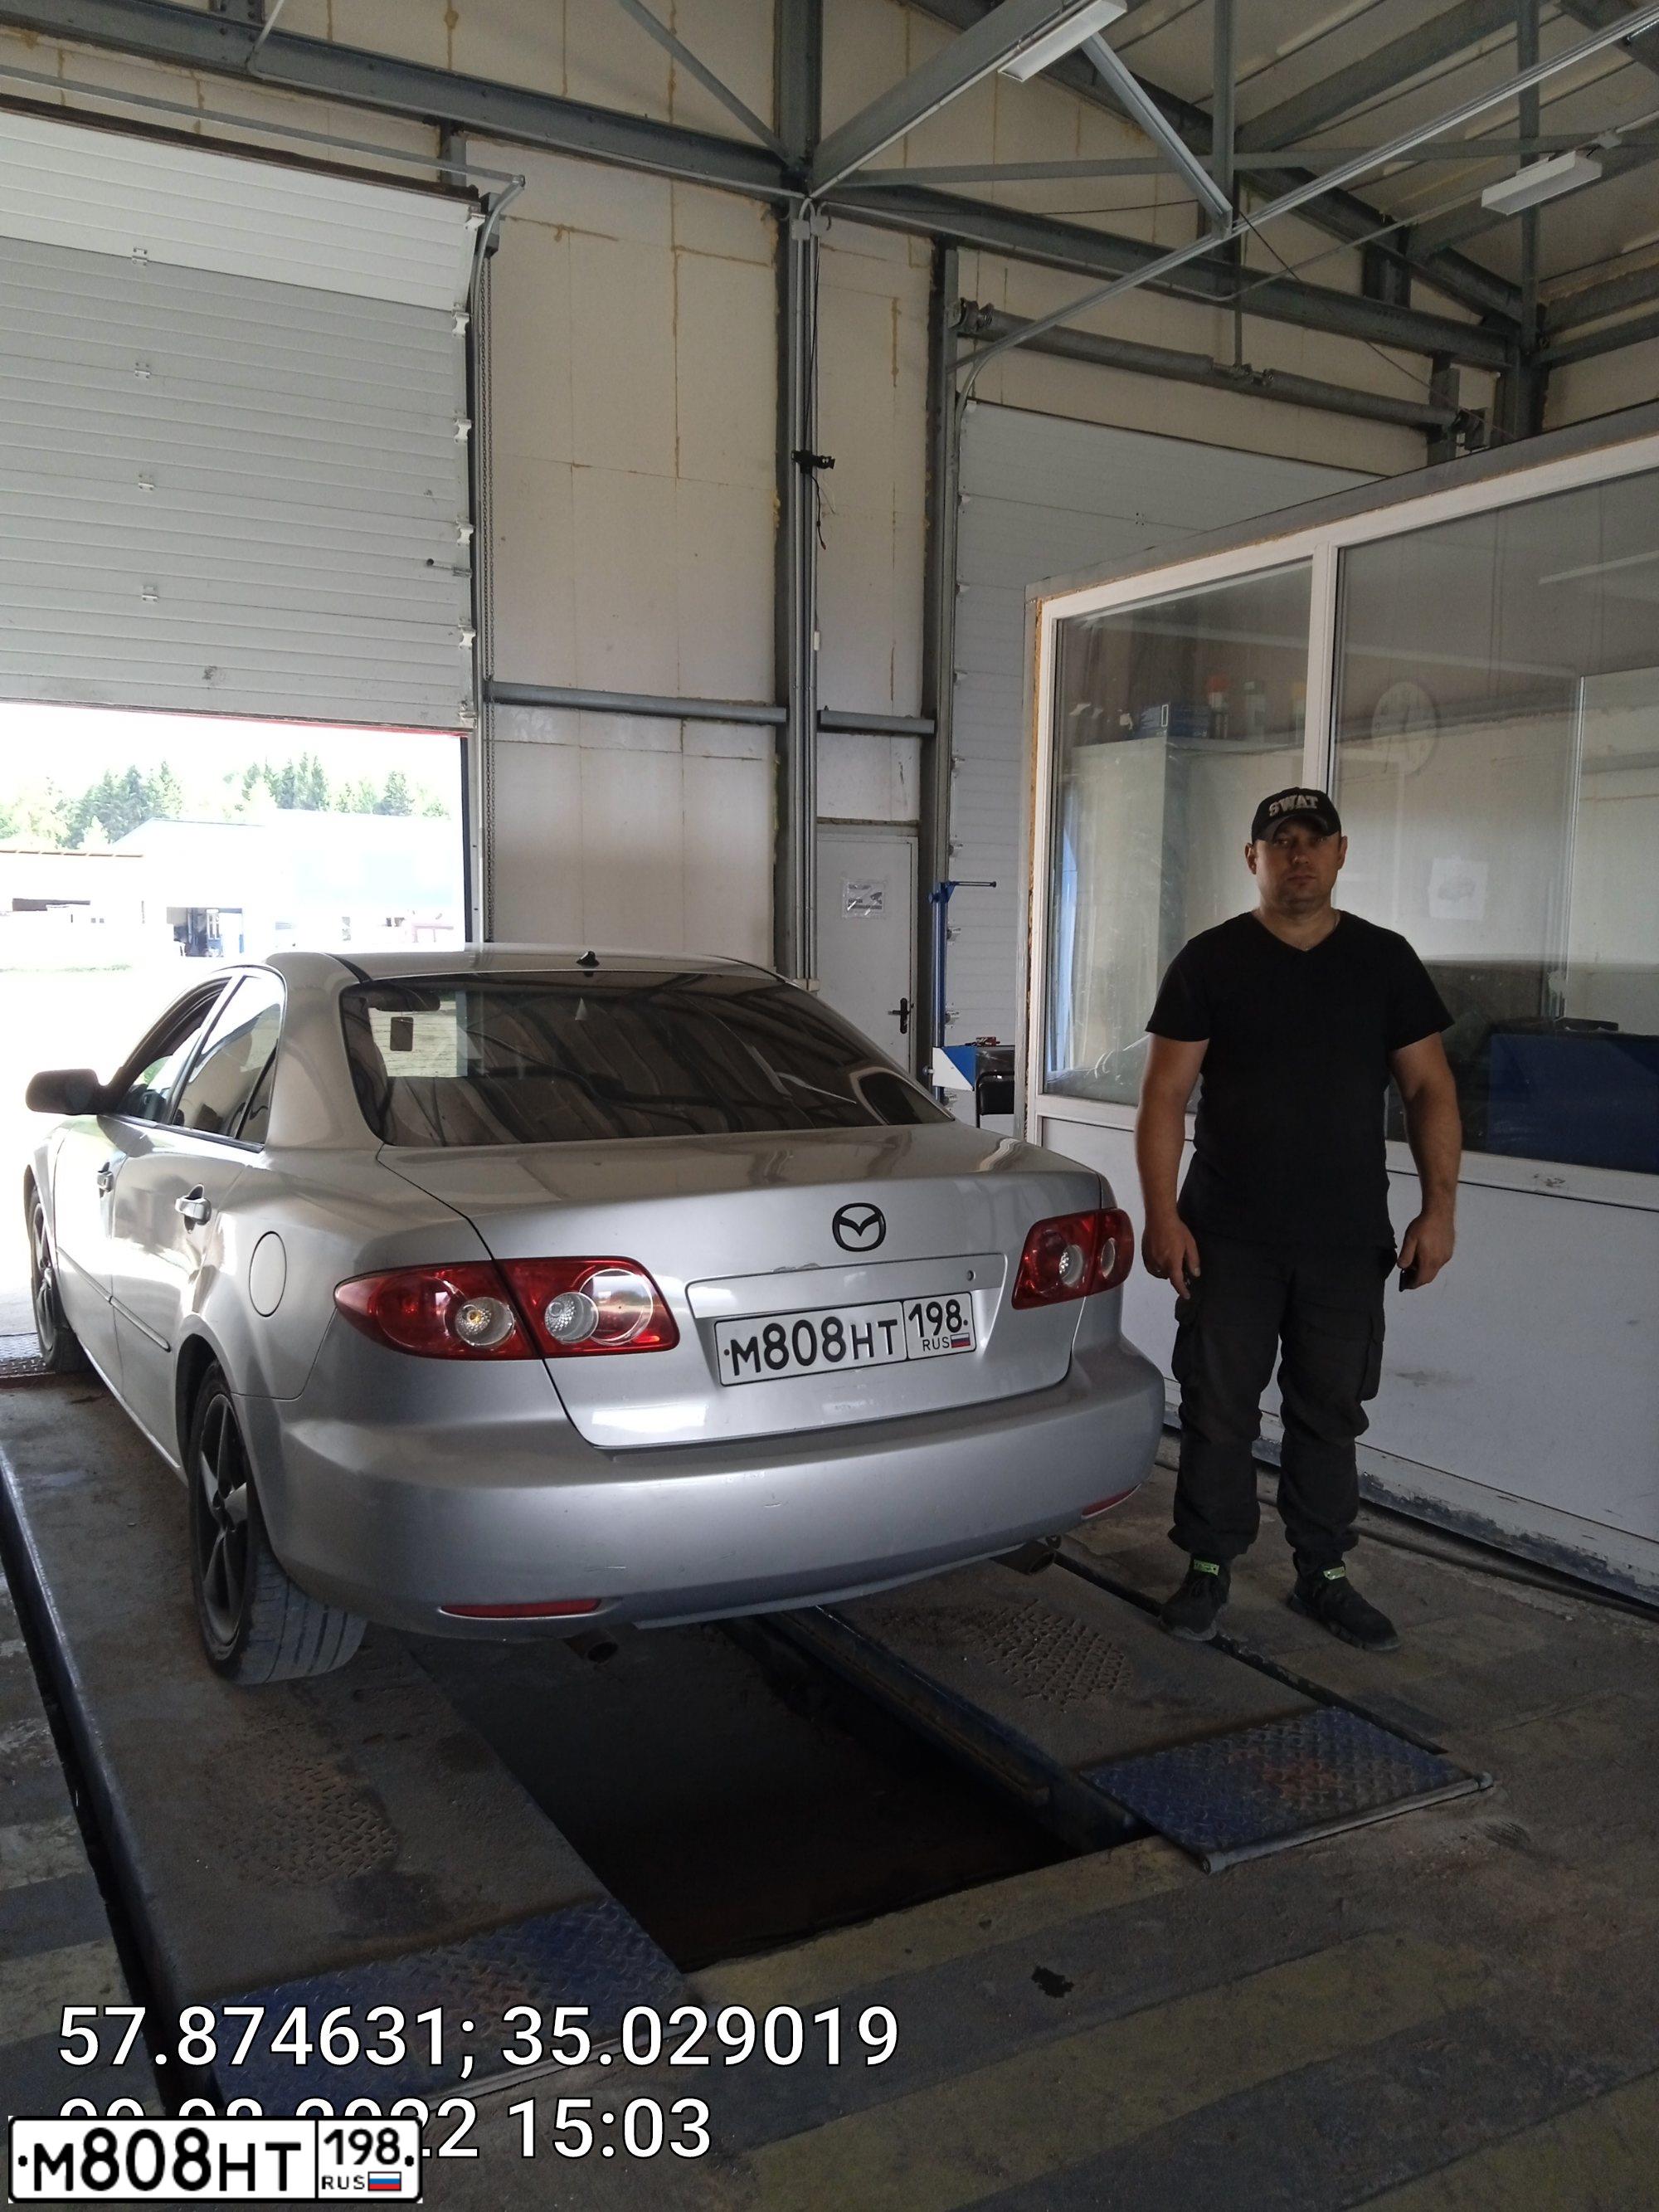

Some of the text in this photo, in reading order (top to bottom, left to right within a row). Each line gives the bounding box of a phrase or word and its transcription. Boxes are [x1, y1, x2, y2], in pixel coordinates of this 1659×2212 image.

[1268, 794, 1319, 817] SWAT
[907, 1298, 961, 1338] 198
[922, 1336, 951, 1352] RUS
